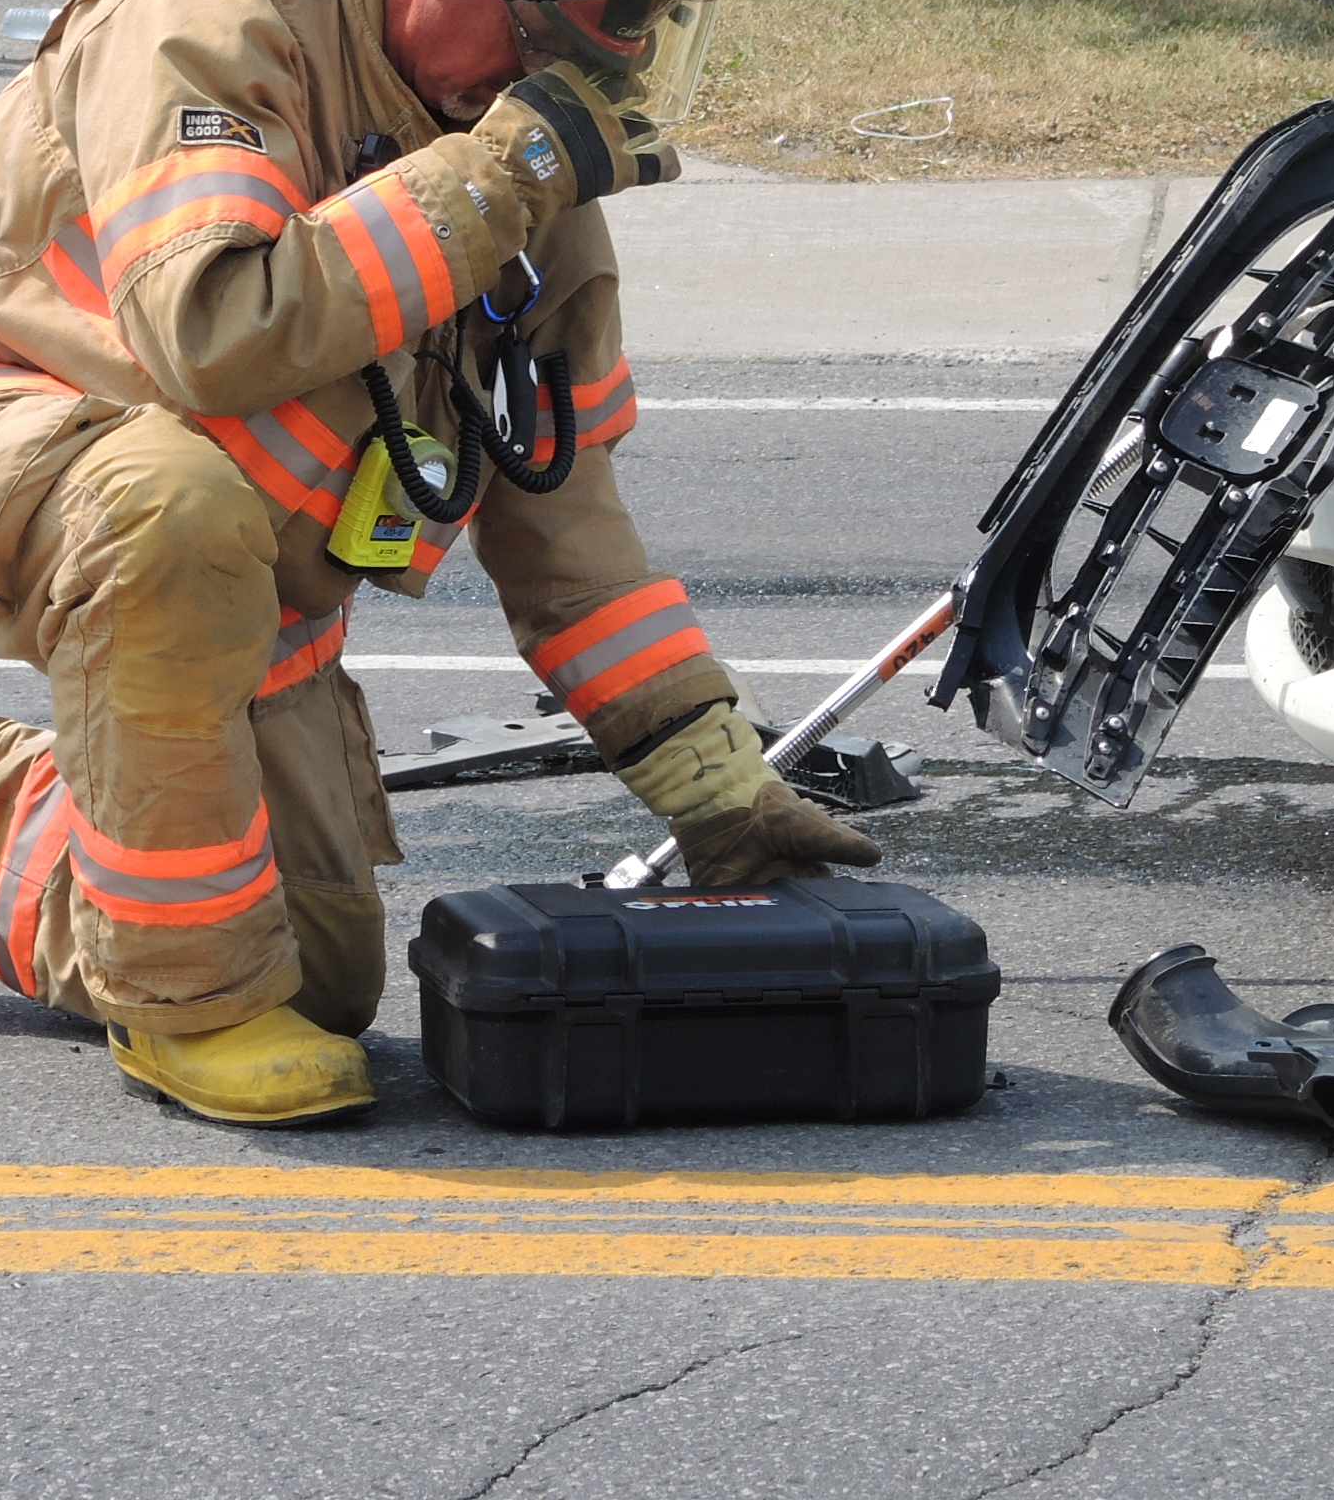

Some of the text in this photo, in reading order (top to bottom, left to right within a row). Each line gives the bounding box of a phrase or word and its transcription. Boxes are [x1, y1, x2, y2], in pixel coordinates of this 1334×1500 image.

[185, 114, 222, 126] INNO
[185, 125, 221, 137] 6000
[464, 181, 490, 217] TITAN
